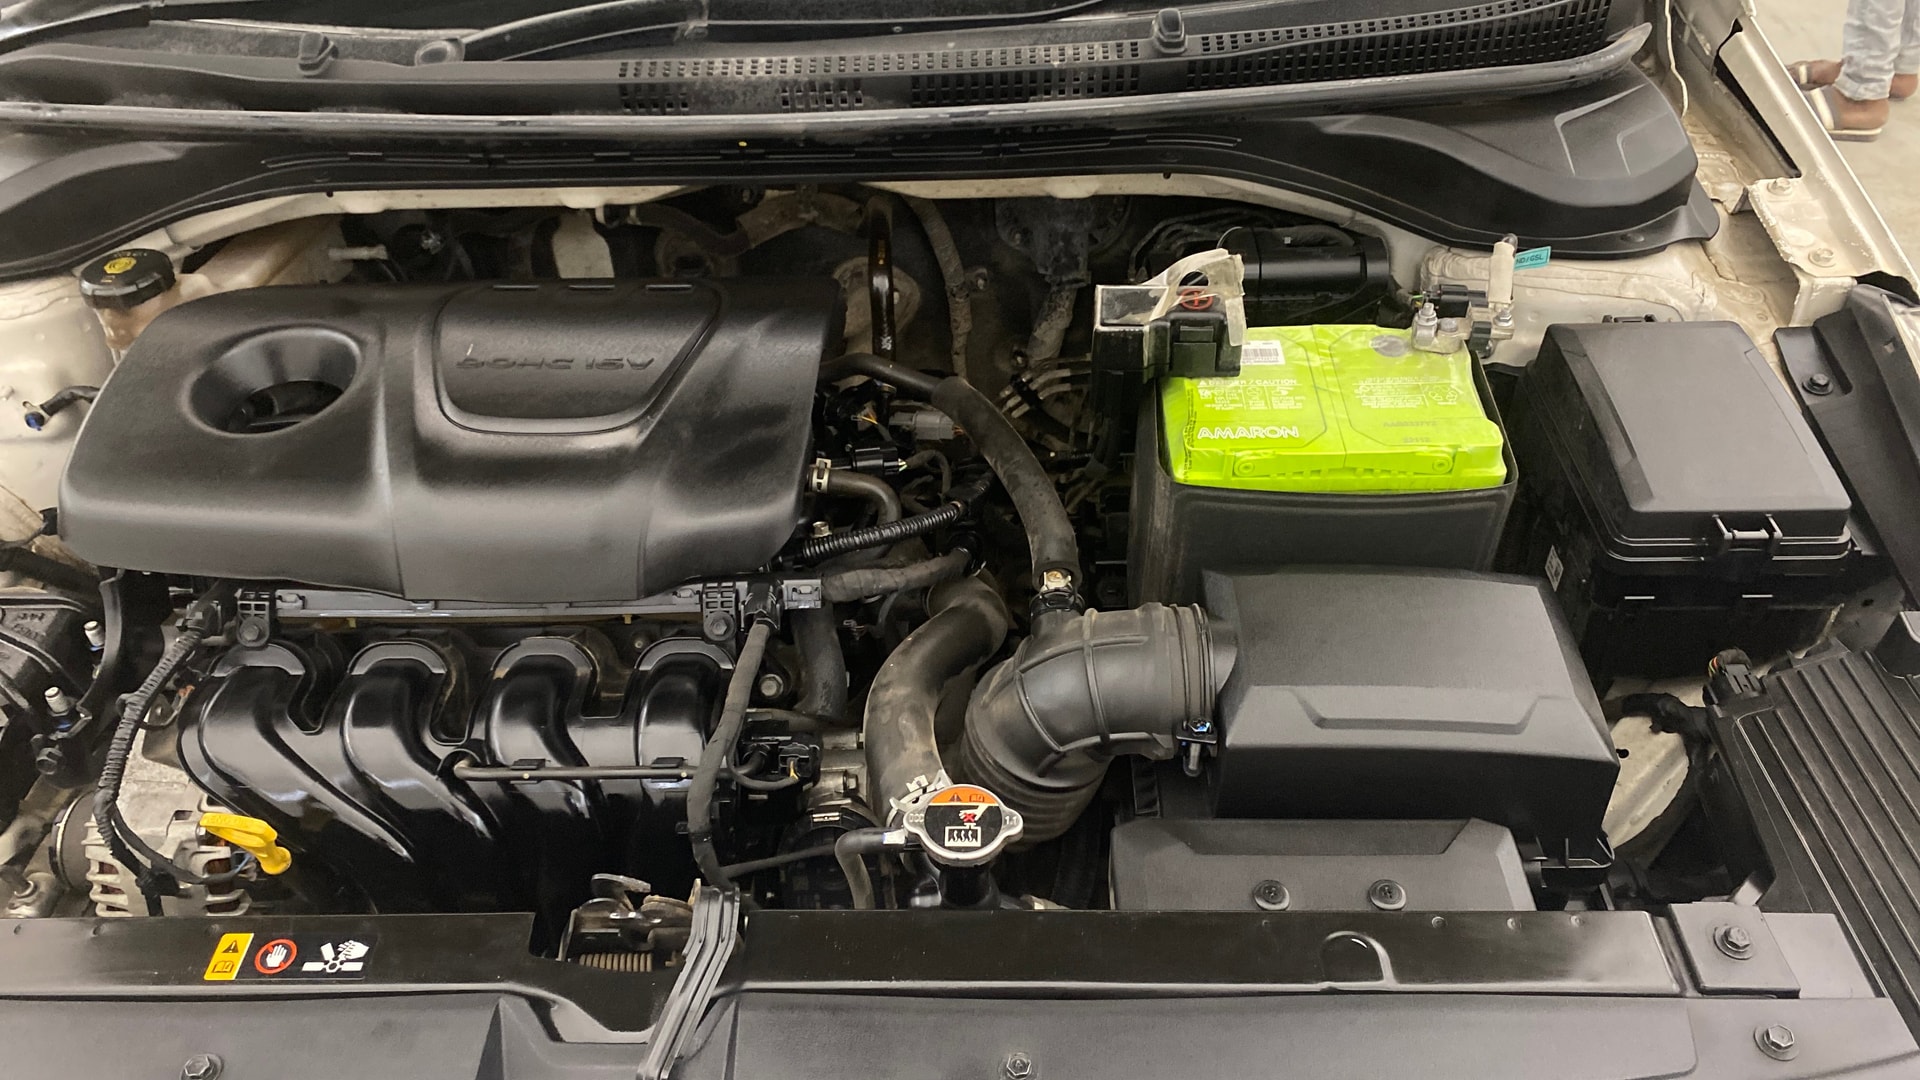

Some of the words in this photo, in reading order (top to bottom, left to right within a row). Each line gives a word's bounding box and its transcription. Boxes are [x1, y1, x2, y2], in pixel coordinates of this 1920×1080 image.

[455, 357, 575, 370] DOHC
[584, 357, 655, 371] 16V
[1255, 378, 1297, 386] CAUTION
[1198, 426, 1299, 439] AMARON
[1004, 815, 1018, 825] 1.1
